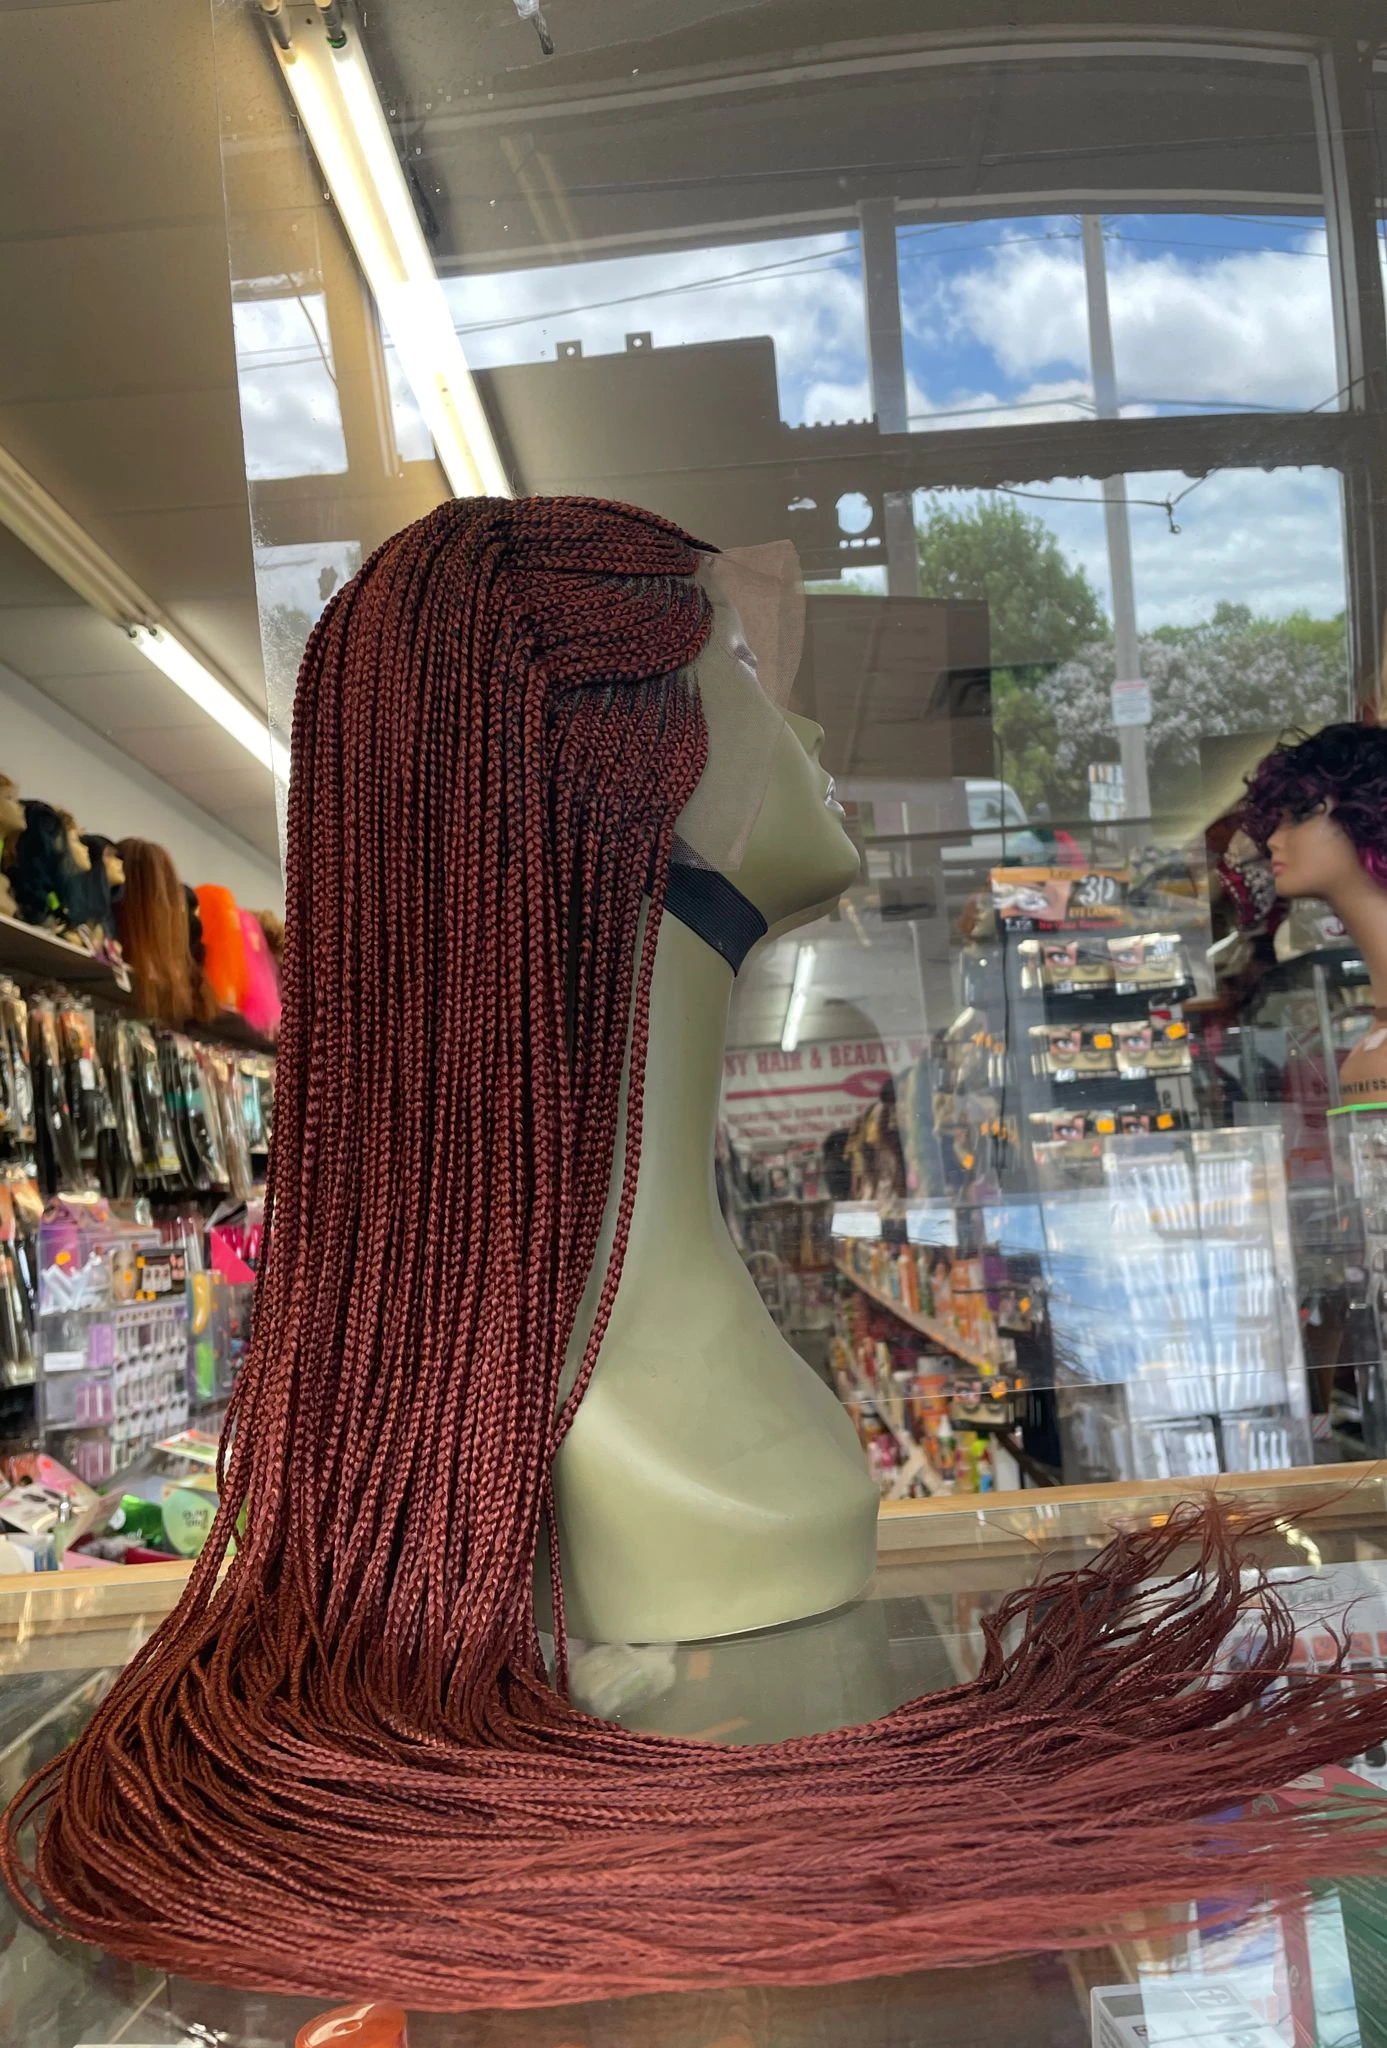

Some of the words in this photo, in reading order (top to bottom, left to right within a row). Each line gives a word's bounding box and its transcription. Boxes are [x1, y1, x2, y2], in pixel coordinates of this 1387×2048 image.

[1079, 875, 1116, 905] 3D
[756, 1049, 802, 1073] HAIR
[811, 1046, 822, 1069] &
[830, 1041, 899, 1067] BEAUTY
